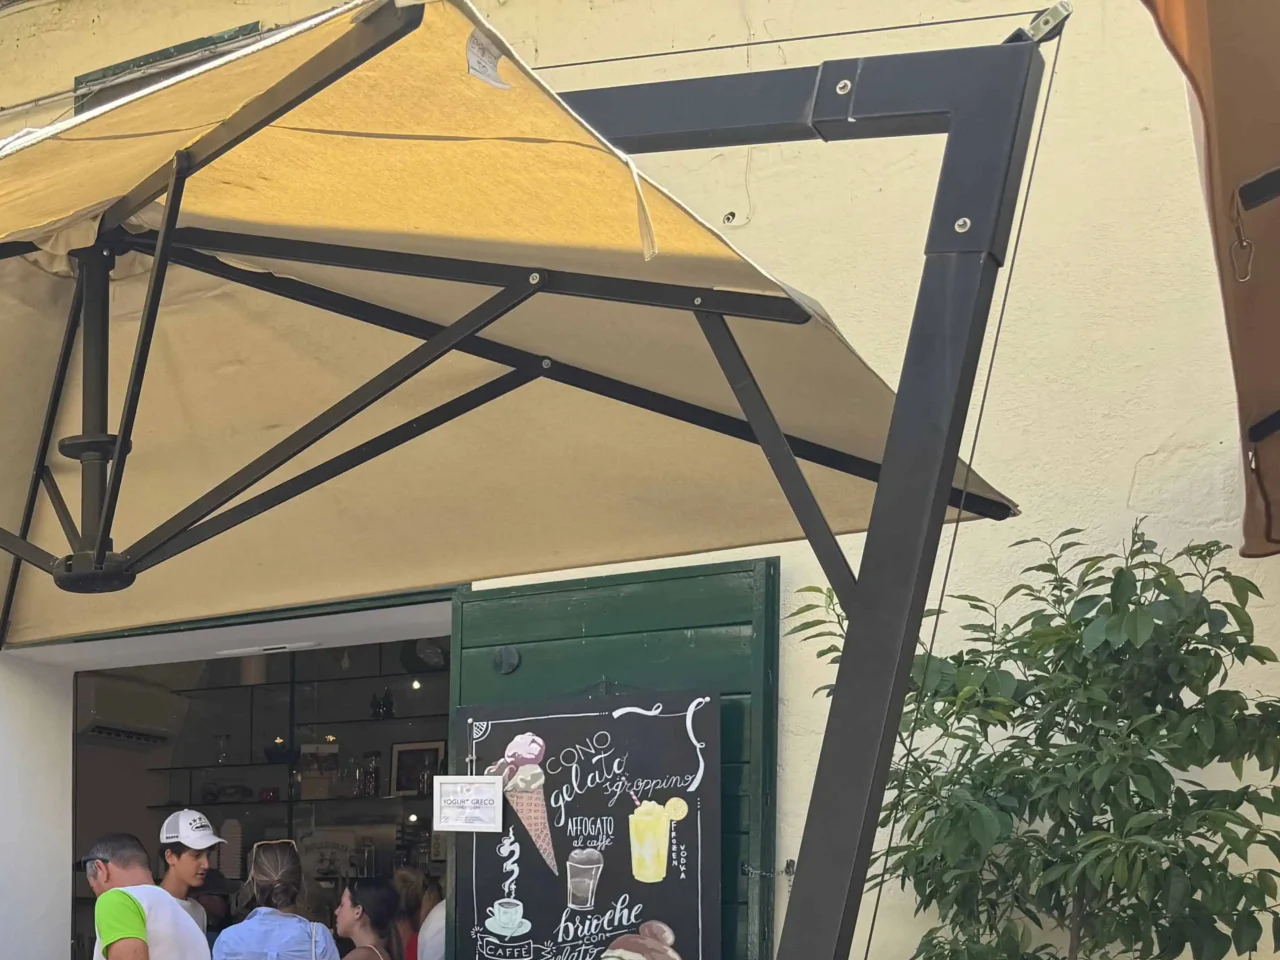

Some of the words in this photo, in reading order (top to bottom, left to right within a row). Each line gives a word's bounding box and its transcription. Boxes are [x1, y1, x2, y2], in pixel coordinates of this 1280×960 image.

[546, 731, 612, 776] CONO
[471, 798, 495, 806] GRECO
[550, 748, 628, 827] gelato
[603, 772, 698, 806] sgroppino
[567, 816, 614, 837] AFFOGATO
[679, 844, 688, 880] VODKA
[553, 893, 643, 944] brioche
[584, 932, 606, 945] con
